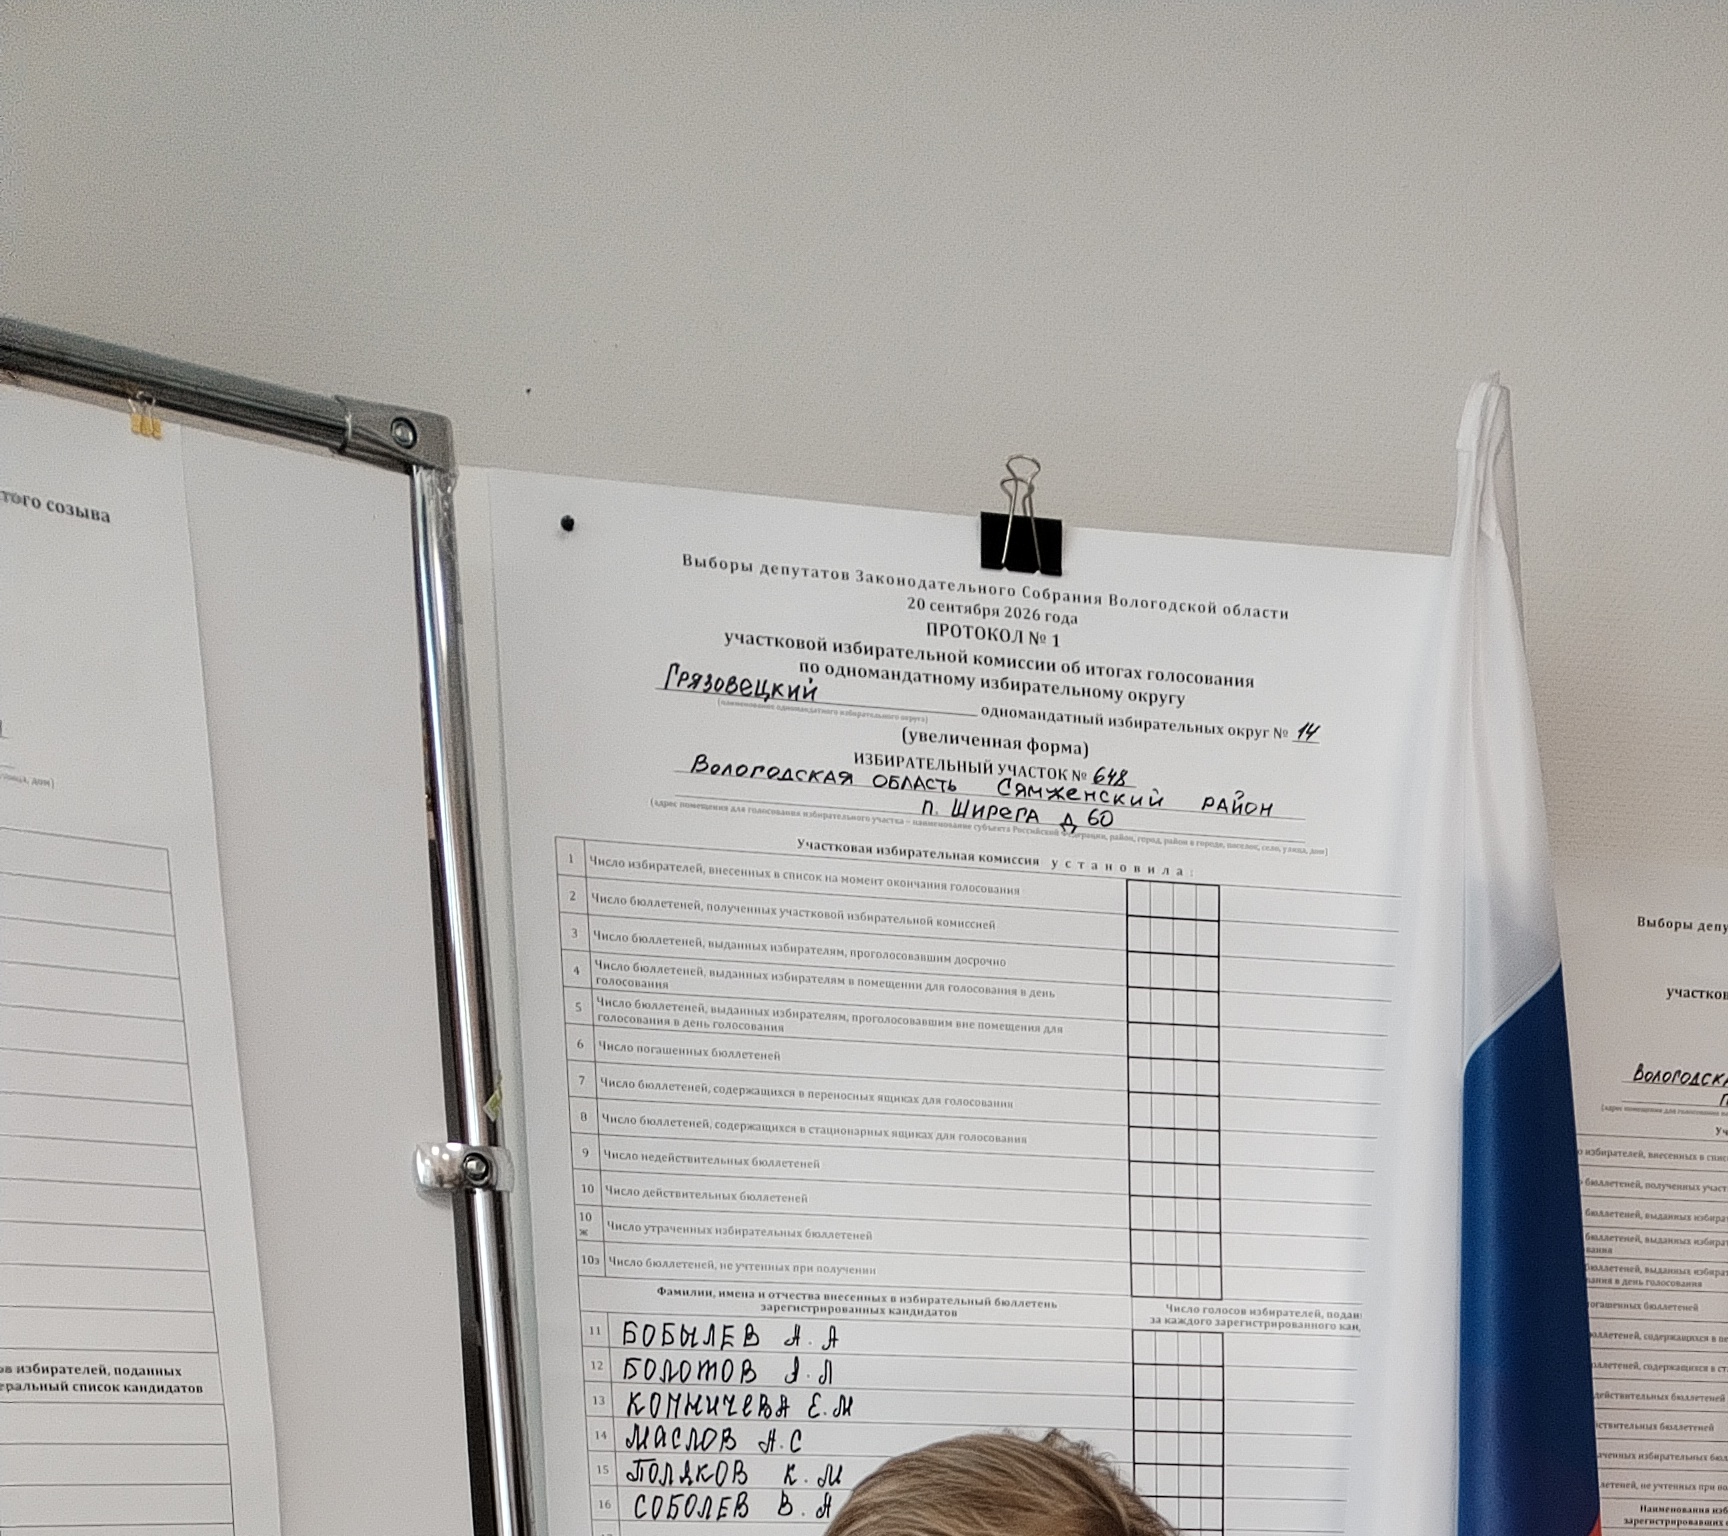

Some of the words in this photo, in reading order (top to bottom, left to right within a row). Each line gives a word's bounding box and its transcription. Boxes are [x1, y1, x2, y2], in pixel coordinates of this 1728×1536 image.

[46, 500, 110, 523] созыва
[683, 554, 752, 574] Выборы
[760, 564, 849, 580] депутатов
[856, 570, 1015, 596] Законодательного
[1022, 586, 1101, 605] Собрания
[1109, 594, 1216, 614] Вологодской
[1223, 604, 1288, 620] области
[908, 597, 925, 610] 20
[930, 602, 999, 619] сентября
[1005, 606, 1040, 621] 2026
[1045, 613, 1077, 626] года
[927, 622, 1023, 644] ПРОТОКОЛ
[1029, 631, 1046, 645] №
[1053, 634, 1058, 647] 1
[725, 633, 827, 651] участковой
[833, 641, 967, 664] избирательной
[974, 655, 1056, 672] комиссии
[1061, 661, 1080, 674] об
[1086, 665, 1141, 679] итогах
[1148, 671, 1254, 688] голосования
[800, 662, 819, 674] по
[825, 665, 975, 690] одномандатному
[981, 677, 1123, 703] избирательному
[1128, 691, 1185, 708] округу
[981, 707, 1103, 725] одномандатный
[1109, 716, 1223, 735] избирательных
[1228, 727, 1270, 741] округ
[1274, 728, 1289, 739] №
[1297, 722, 1321, 742] 14
[902, 727, 1021, 750] (увеличенная
[1027, 737, 1088, 759] форма)
[854, 752, 992, 775] ИЗБИРАТЕЛЬНЫЙ
[998, 764, 1067, 781] УЧАСТОК
[1072, 770, 1087, 781] №
[1092, 766, 1129, 787] 648
[1087, 809, 1114, 828] 60
[798, 839, 872, 854] Участковая
[877, 846, 975, 861] избирательная
[979, 855, 1039, 866] комиссия
[590, 855, 625, 868] Число
[628, 860, 705, 875] избирателей,
[709, 867, 771, 878] внесенных
[774, 871, 780, 879] в
[783, 872, 822, 882] список
[841, 876, 884, 886] момент
[886, 879, 947, 890] окончания
[950, 883, 1020, 895] голосования
[591, 892, 627, 905] Число
[630, 896, 703, 912] бюллетеней,
[707, 903, 776, 915] полученных
[779, 908, 844, 920] участковой
[847, 912, 933, 926] избирательной
[937, 919, 995, 930] комиссией
[1637, 916, 1693, 932] Выборы
[590, 1326, 601, 1336] 11
[623, 1320, 760, 1350] БОБЫЛЕВ
[16, 1363, 110, 1377] избирателей,
[114, 1367, 181, 1377] поданных
[591, 1361, 603, 1371] 12
[623, 1356, 757, 1384] БОЛОТОВ
[73, 1384, 120, 1392] список
[124, 1384, 203, 1394] кандидатов
[592, 1396, 605, 1406] 13
[595, 1430, 607, 1441] 14
[597, 1465, 609, 1475] 15
[599, 1499, 612, 1510] 16
[634, 1491, 749, 1521] СОБОЛЕВ
